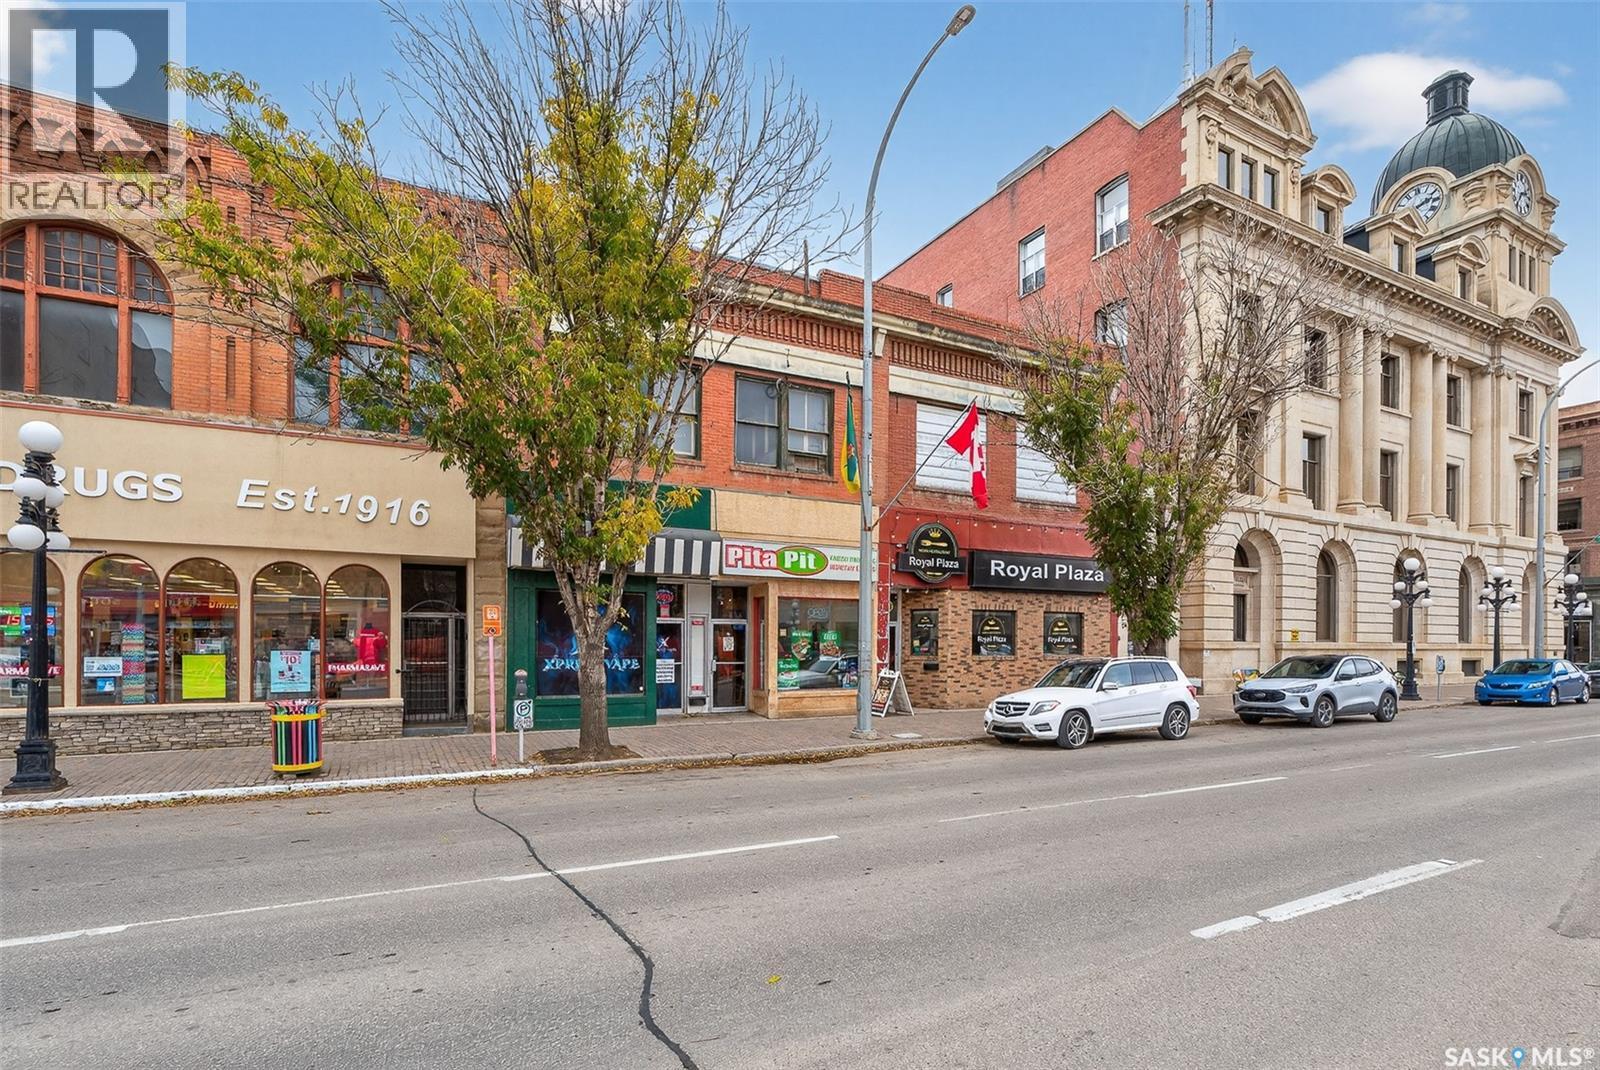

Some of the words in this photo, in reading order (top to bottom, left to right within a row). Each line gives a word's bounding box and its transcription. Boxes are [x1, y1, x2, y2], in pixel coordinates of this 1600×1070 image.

[725, 544, 778, 570] Pita
[784, 550, 817, 570] Pit
[909, 556, 935, 569] Royal
[936, 558, 960, 569] Plaza
[990, 559, 1049, 582] Royal
[1055, 563, 1105, 582] Plaza
[603, 654, 640, 671] VAPE
